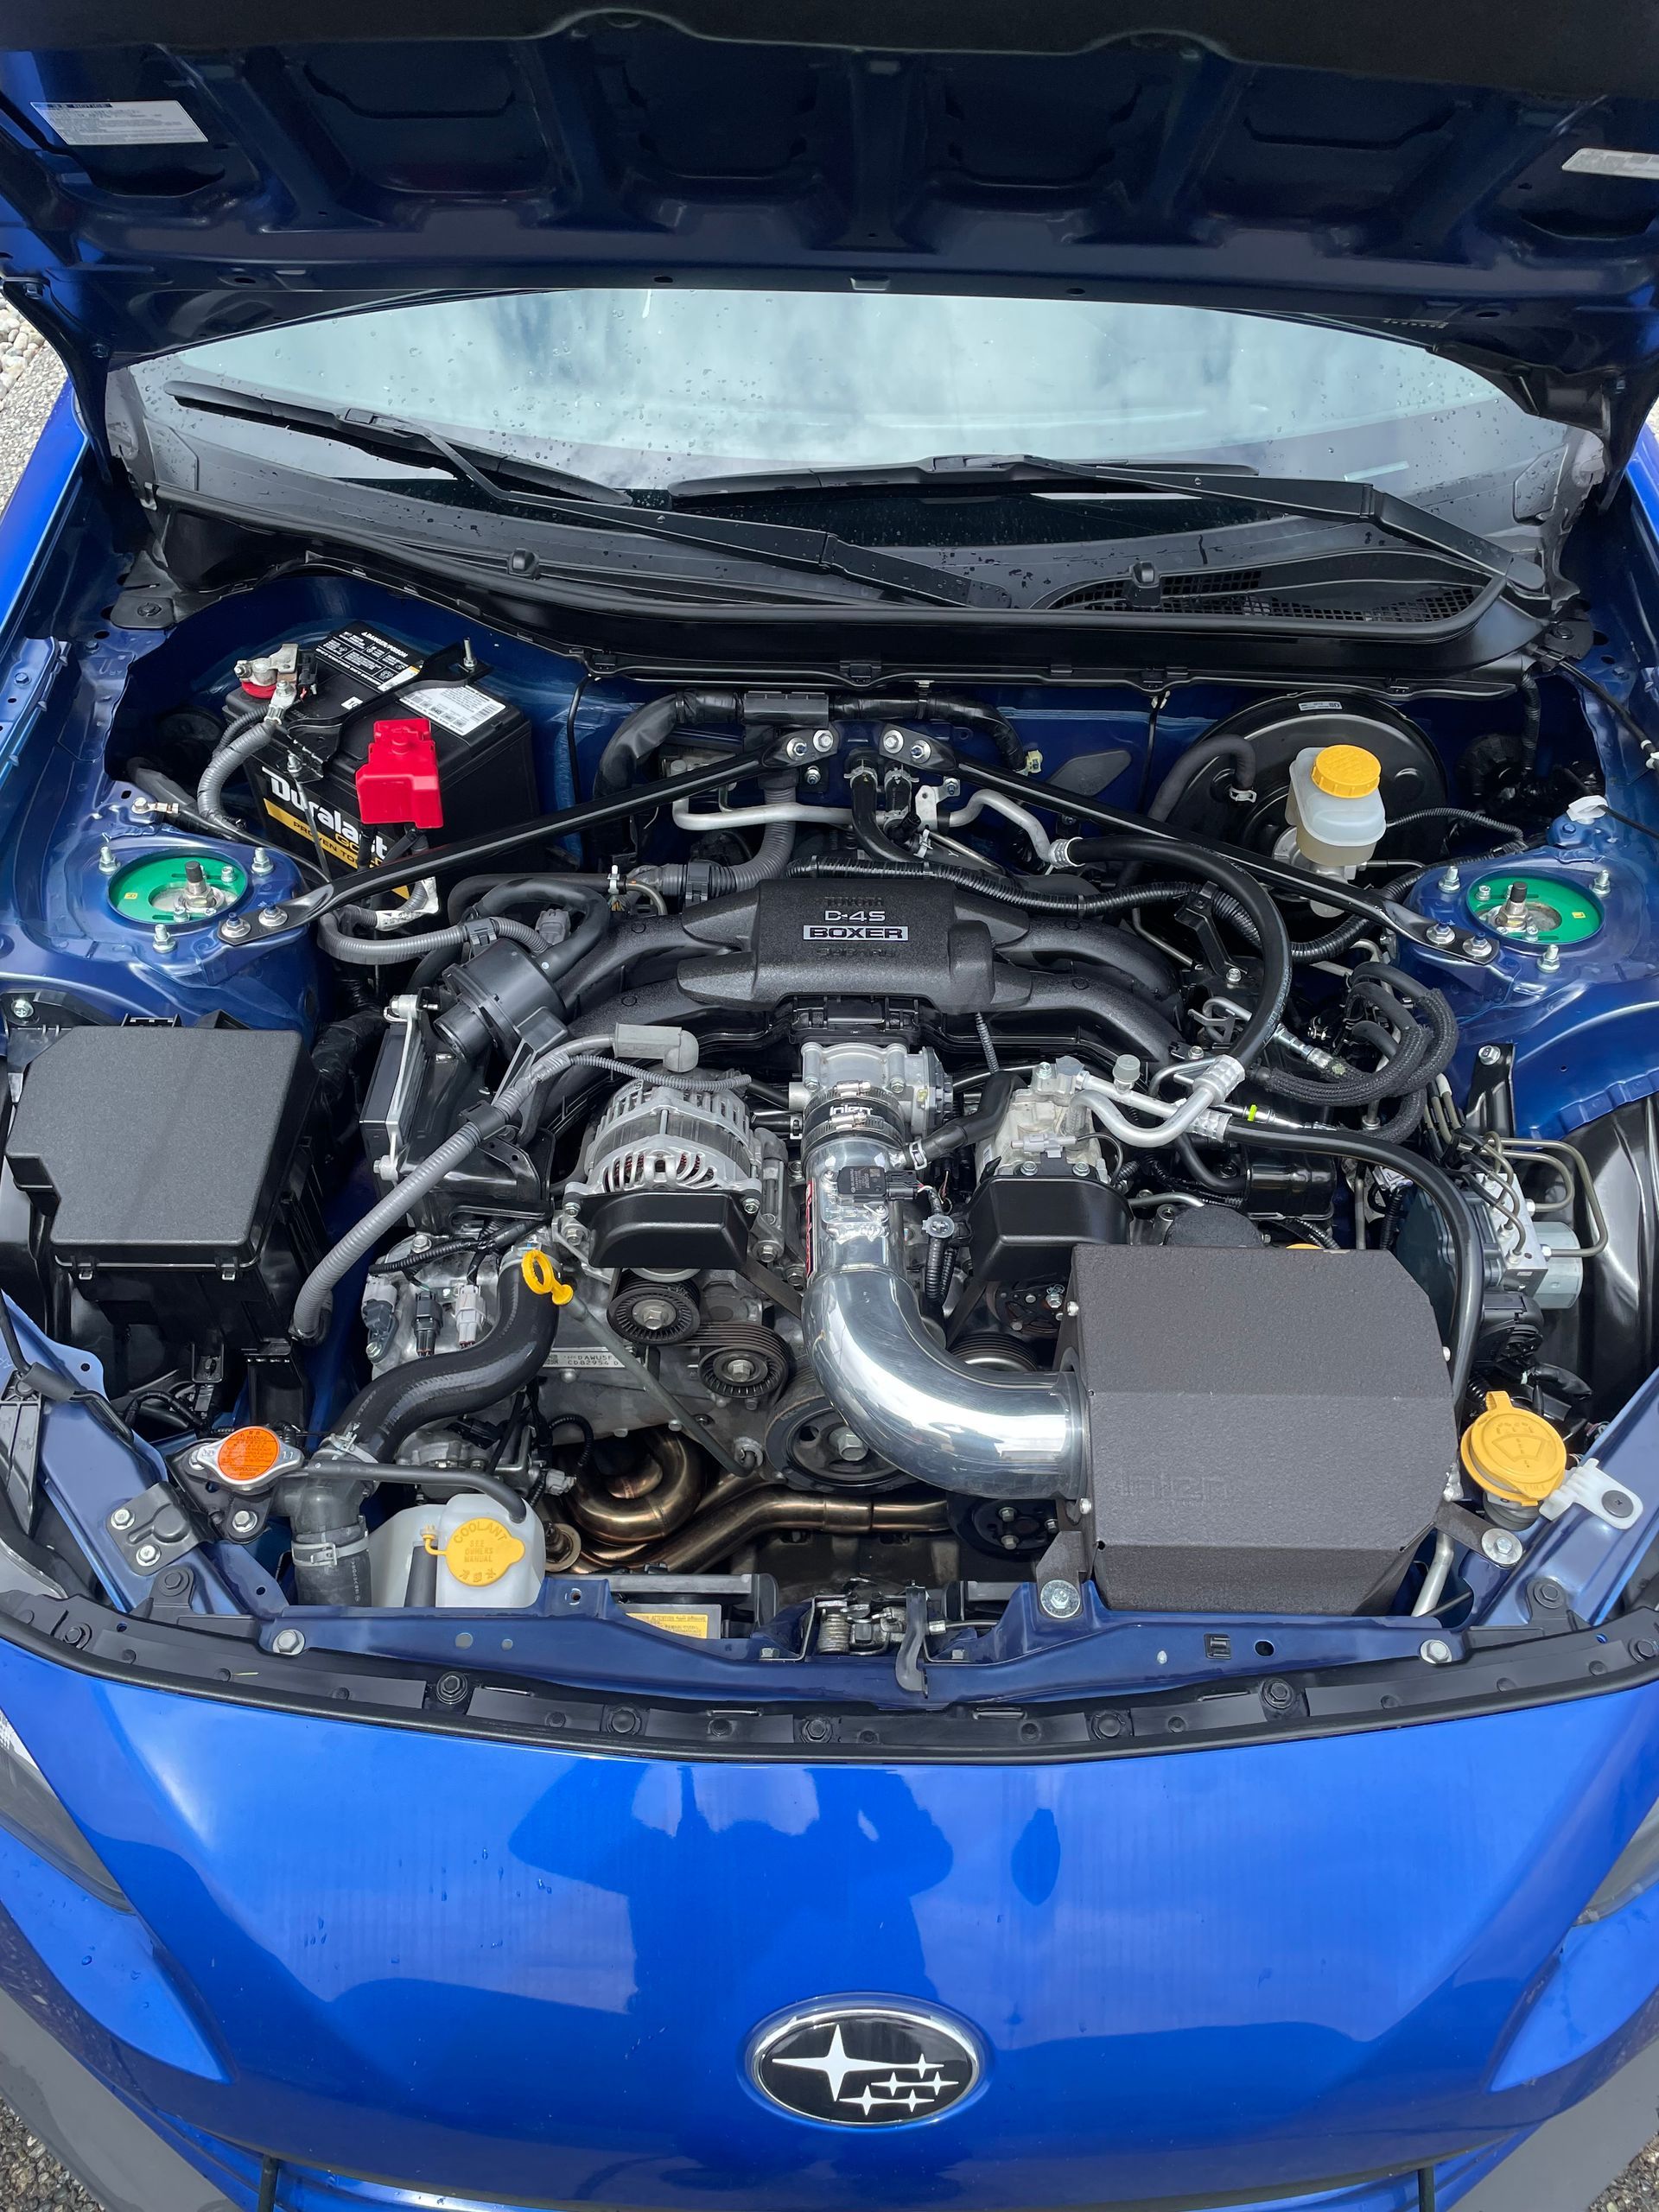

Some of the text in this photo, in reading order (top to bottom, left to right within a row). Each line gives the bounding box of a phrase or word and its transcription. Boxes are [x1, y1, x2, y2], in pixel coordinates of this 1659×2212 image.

[262, 766, 388, 860] Duralat
[824, 910, 886, 922] D-4S
[809, 927, 903, 939] BOXER
[454, 1521, 508, 1544] COOLANT
[464, 1554, 493, 1563] MANUAL
